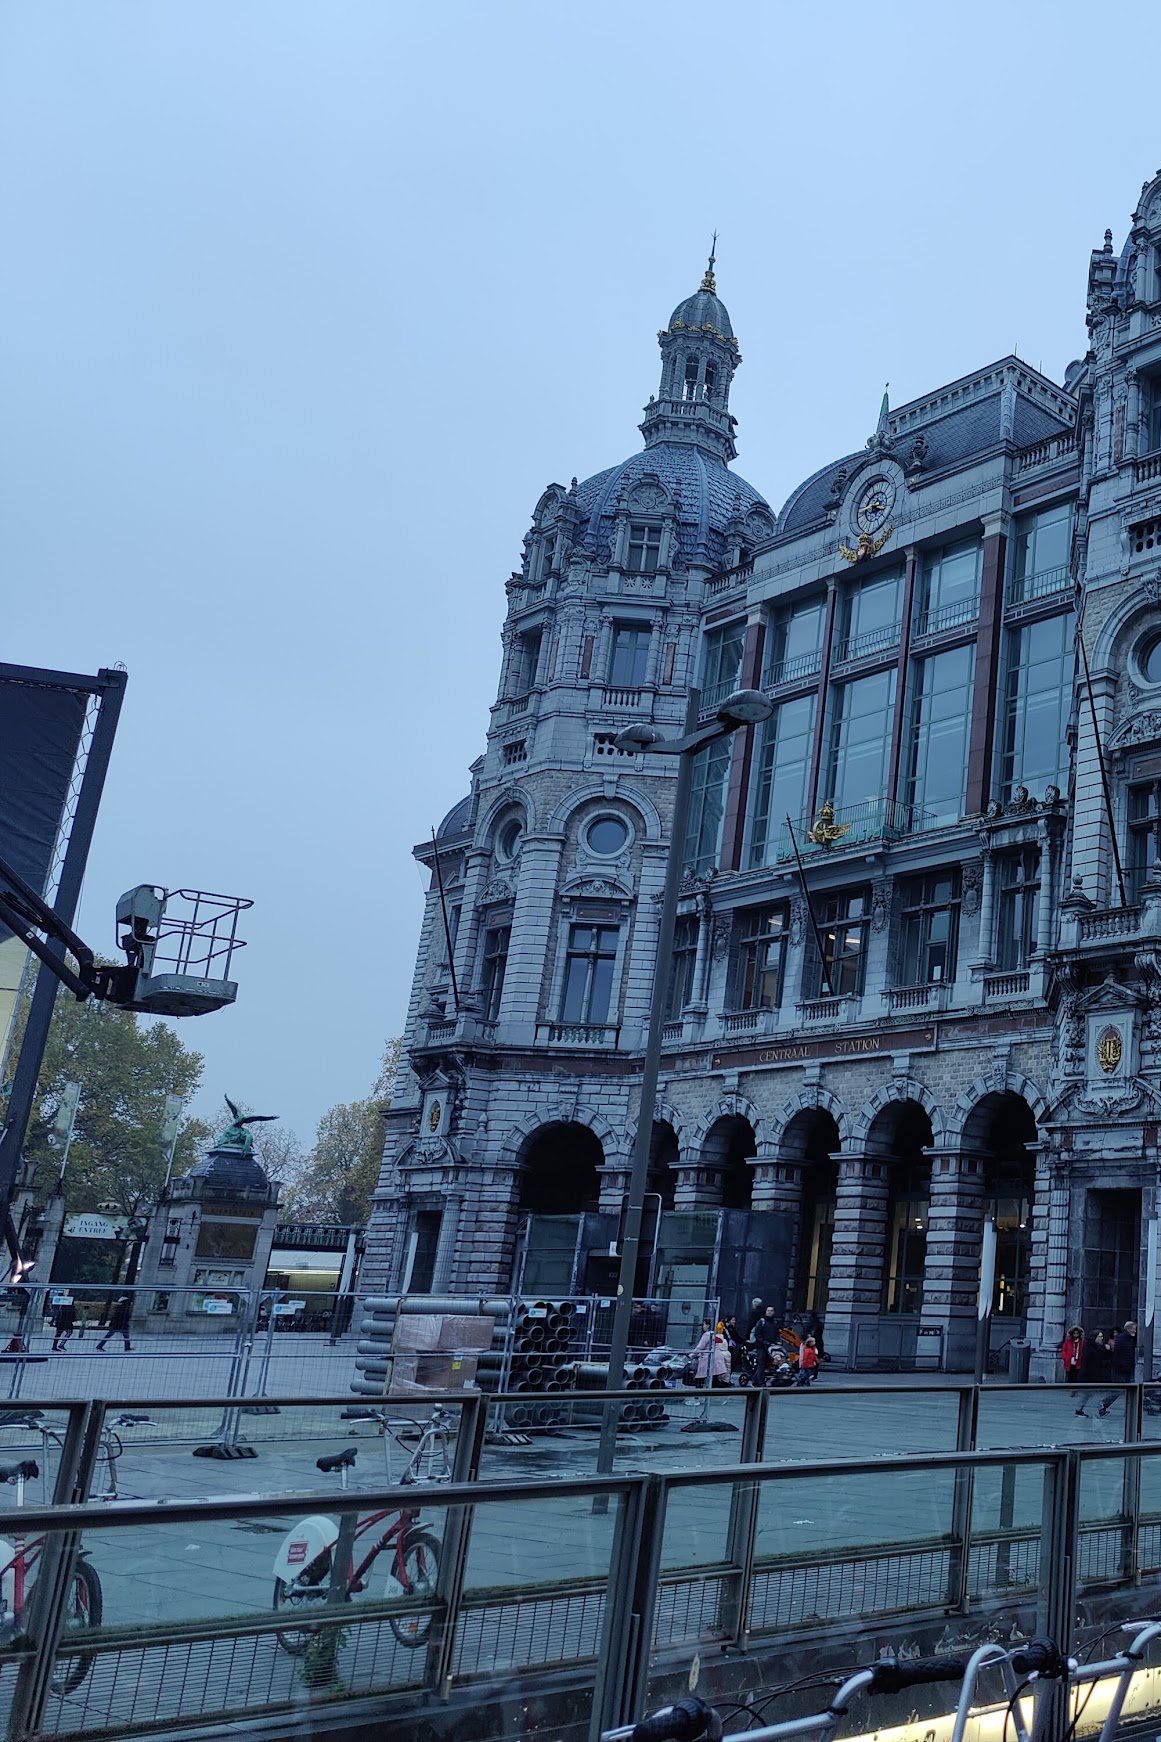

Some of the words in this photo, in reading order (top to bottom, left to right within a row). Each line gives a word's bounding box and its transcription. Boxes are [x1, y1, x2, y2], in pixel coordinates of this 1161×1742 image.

[759, 1046, 811, 1062] CENTRAAL
[835, 1038, 880, 1053] STATION
[80, 1220, 109, 1228] INGANG
